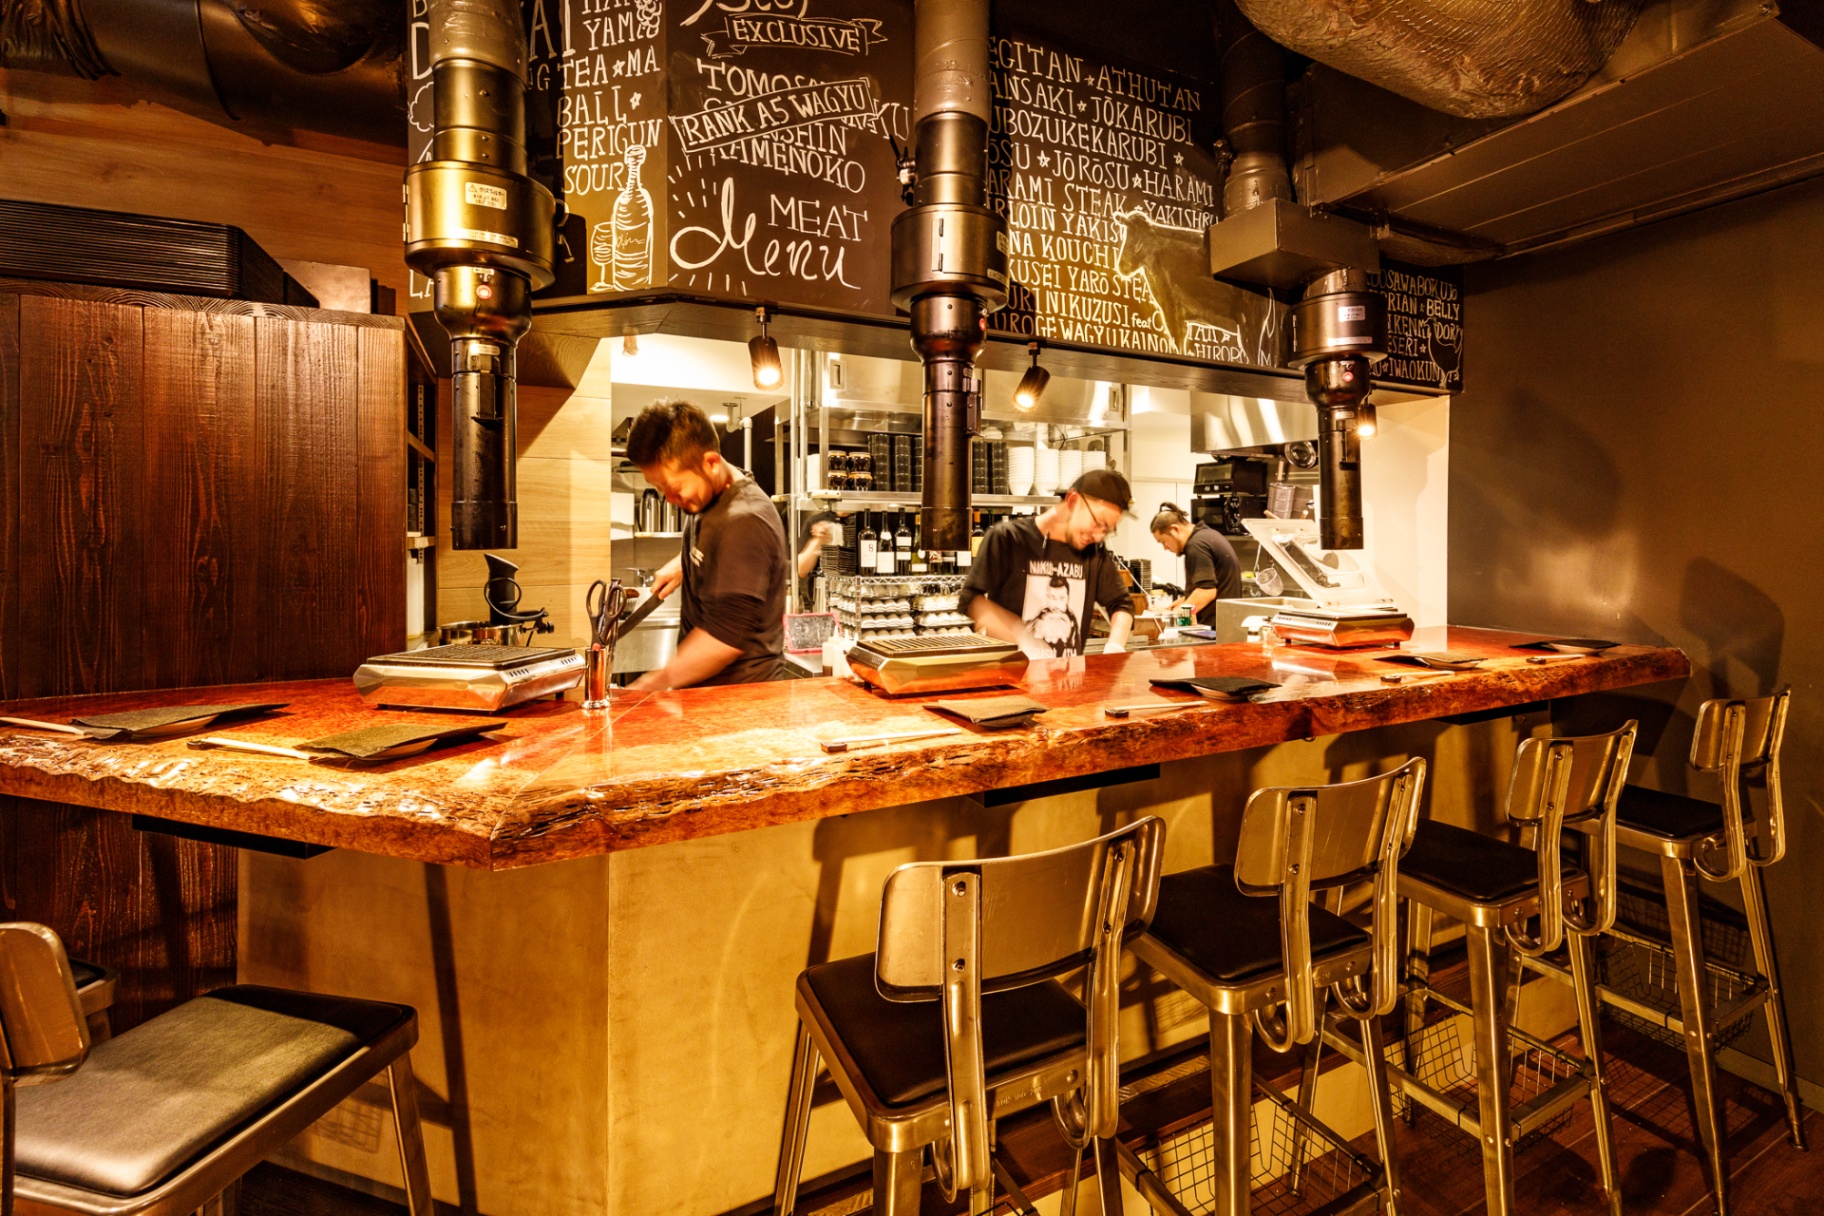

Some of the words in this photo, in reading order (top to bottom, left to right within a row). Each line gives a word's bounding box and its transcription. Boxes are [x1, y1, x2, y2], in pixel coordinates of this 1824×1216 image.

[583, 11, 644, 51] YAM
[732, 18, 861, 52] EXCLUSIVE
[625, 45, 661, 78] MA
[556, 85, 627, 128] BALL
[989, 71, 1077, 119] ANSAKI
[1096, 64, 1201, 112] ATHUTAN
[682, 104, 755, 147] RANK
[756, 95, 790, 130] A5
[786, 83, 868, 119] WAGYU
[988, 105, 1168, 170] UBOZUKEKARUBI
[563, 162, 627, 196] SOUR
[711, 137, 866, 193] AMENOKO
[987, 138, 1031, 170] ŌSU
[1142, 168, 1215, 208] HARAMI
[986, 169, 1056, 207] ARAMI
[1062, 182, 1128, 219] STEAK
[669, 176, 862, 290] Menu
[767, 193, 869, 243] MEAT
[1111, 274, 1156, 304] STEA
[1425, 298, 1461, 322] BELLY
[1131, 312, 1152, 330] feat
[1387, 334, 1419, 358] ESERI
